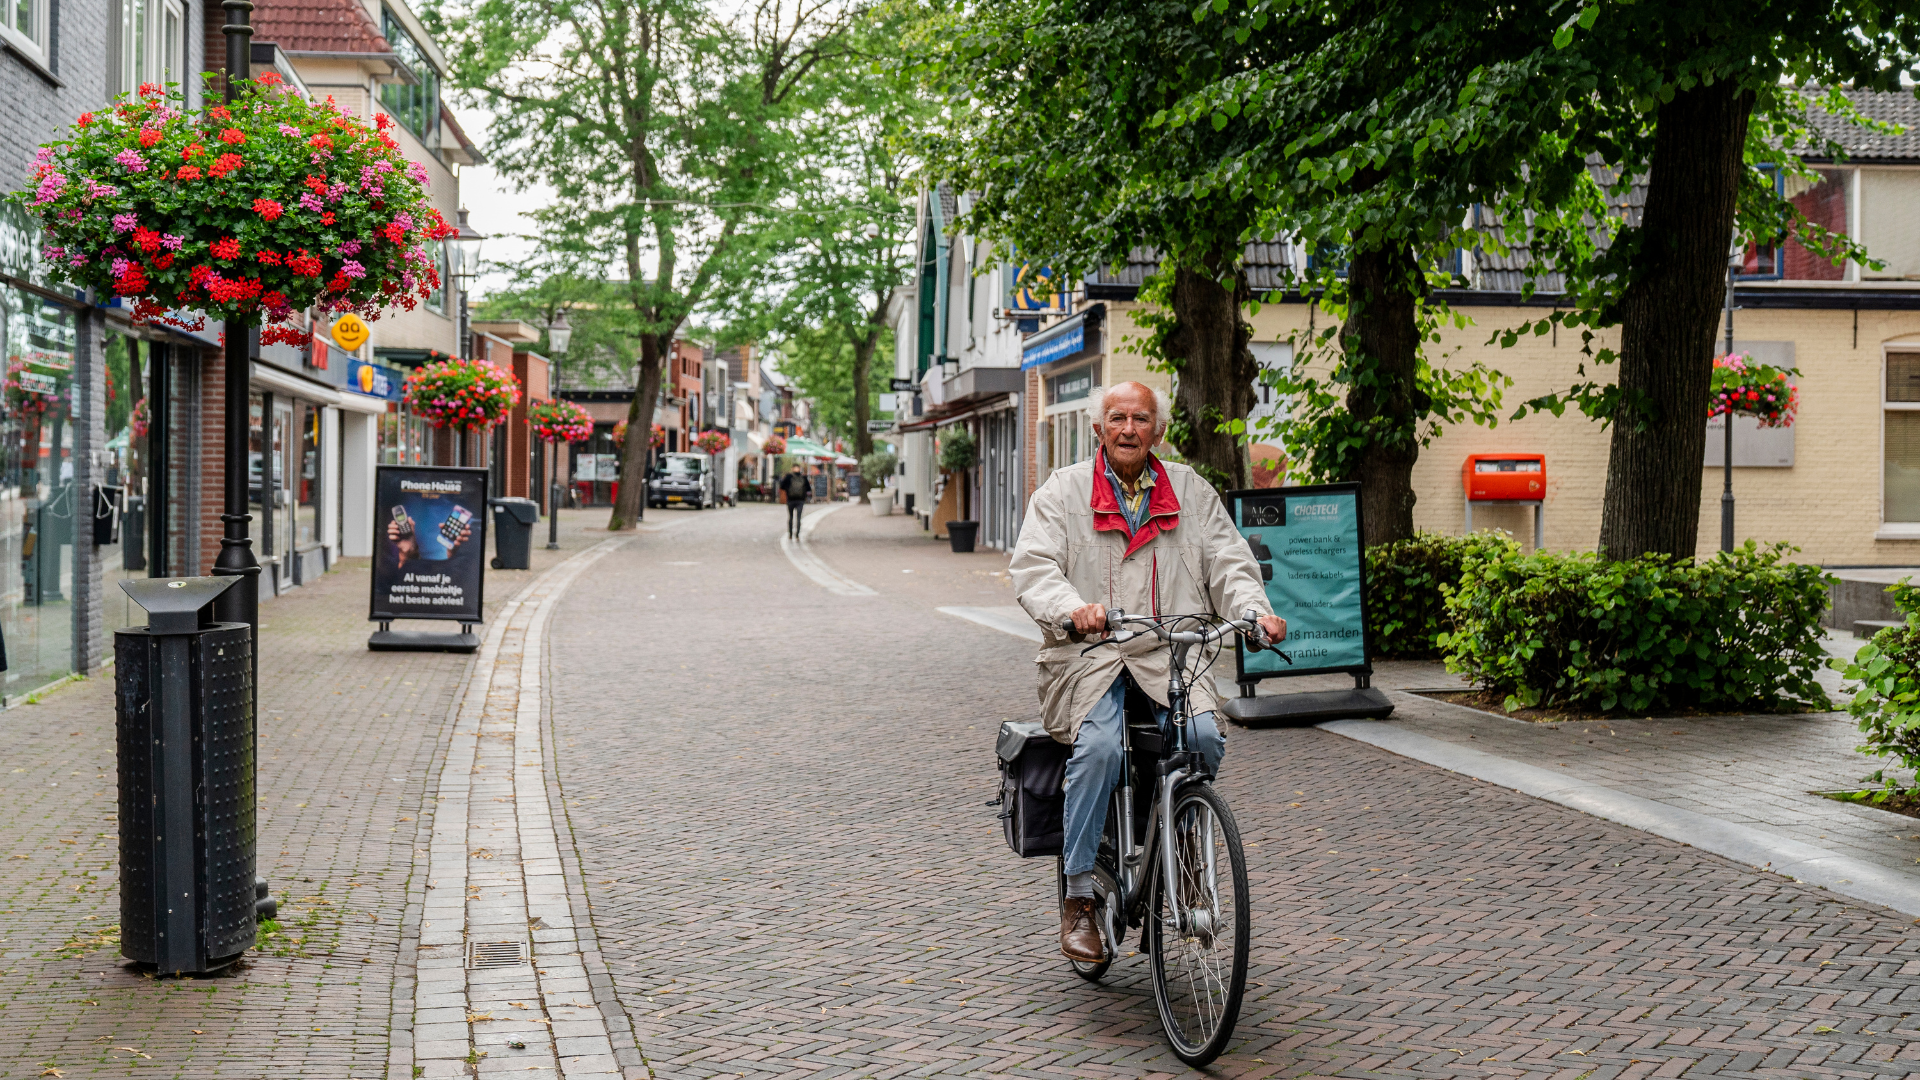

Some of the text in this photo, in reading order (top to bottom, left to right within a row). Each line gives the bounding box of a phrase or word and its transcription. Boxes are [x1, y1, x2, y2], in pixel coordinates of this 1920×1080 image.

[401, 480, 461, 492] Phone House
[1294, 504, 1338, 516] CHOETECH
[1288, 535, 1341, 545] power bank &
[1284, 546, 1346, 556] wireless chargers
[403, 573, 451, 585] Al vanaf je
[1311, 572, 1319, 580] &
[1320, 571, 1343, 579] kabels
[391, 585, 463, 597] eerste mobieltje
[389, 594, 464, 606] het beste advies!
[1294, 600, 1333, 608] autoladers
[1288, 627, 1359, 641] 18 maanden
